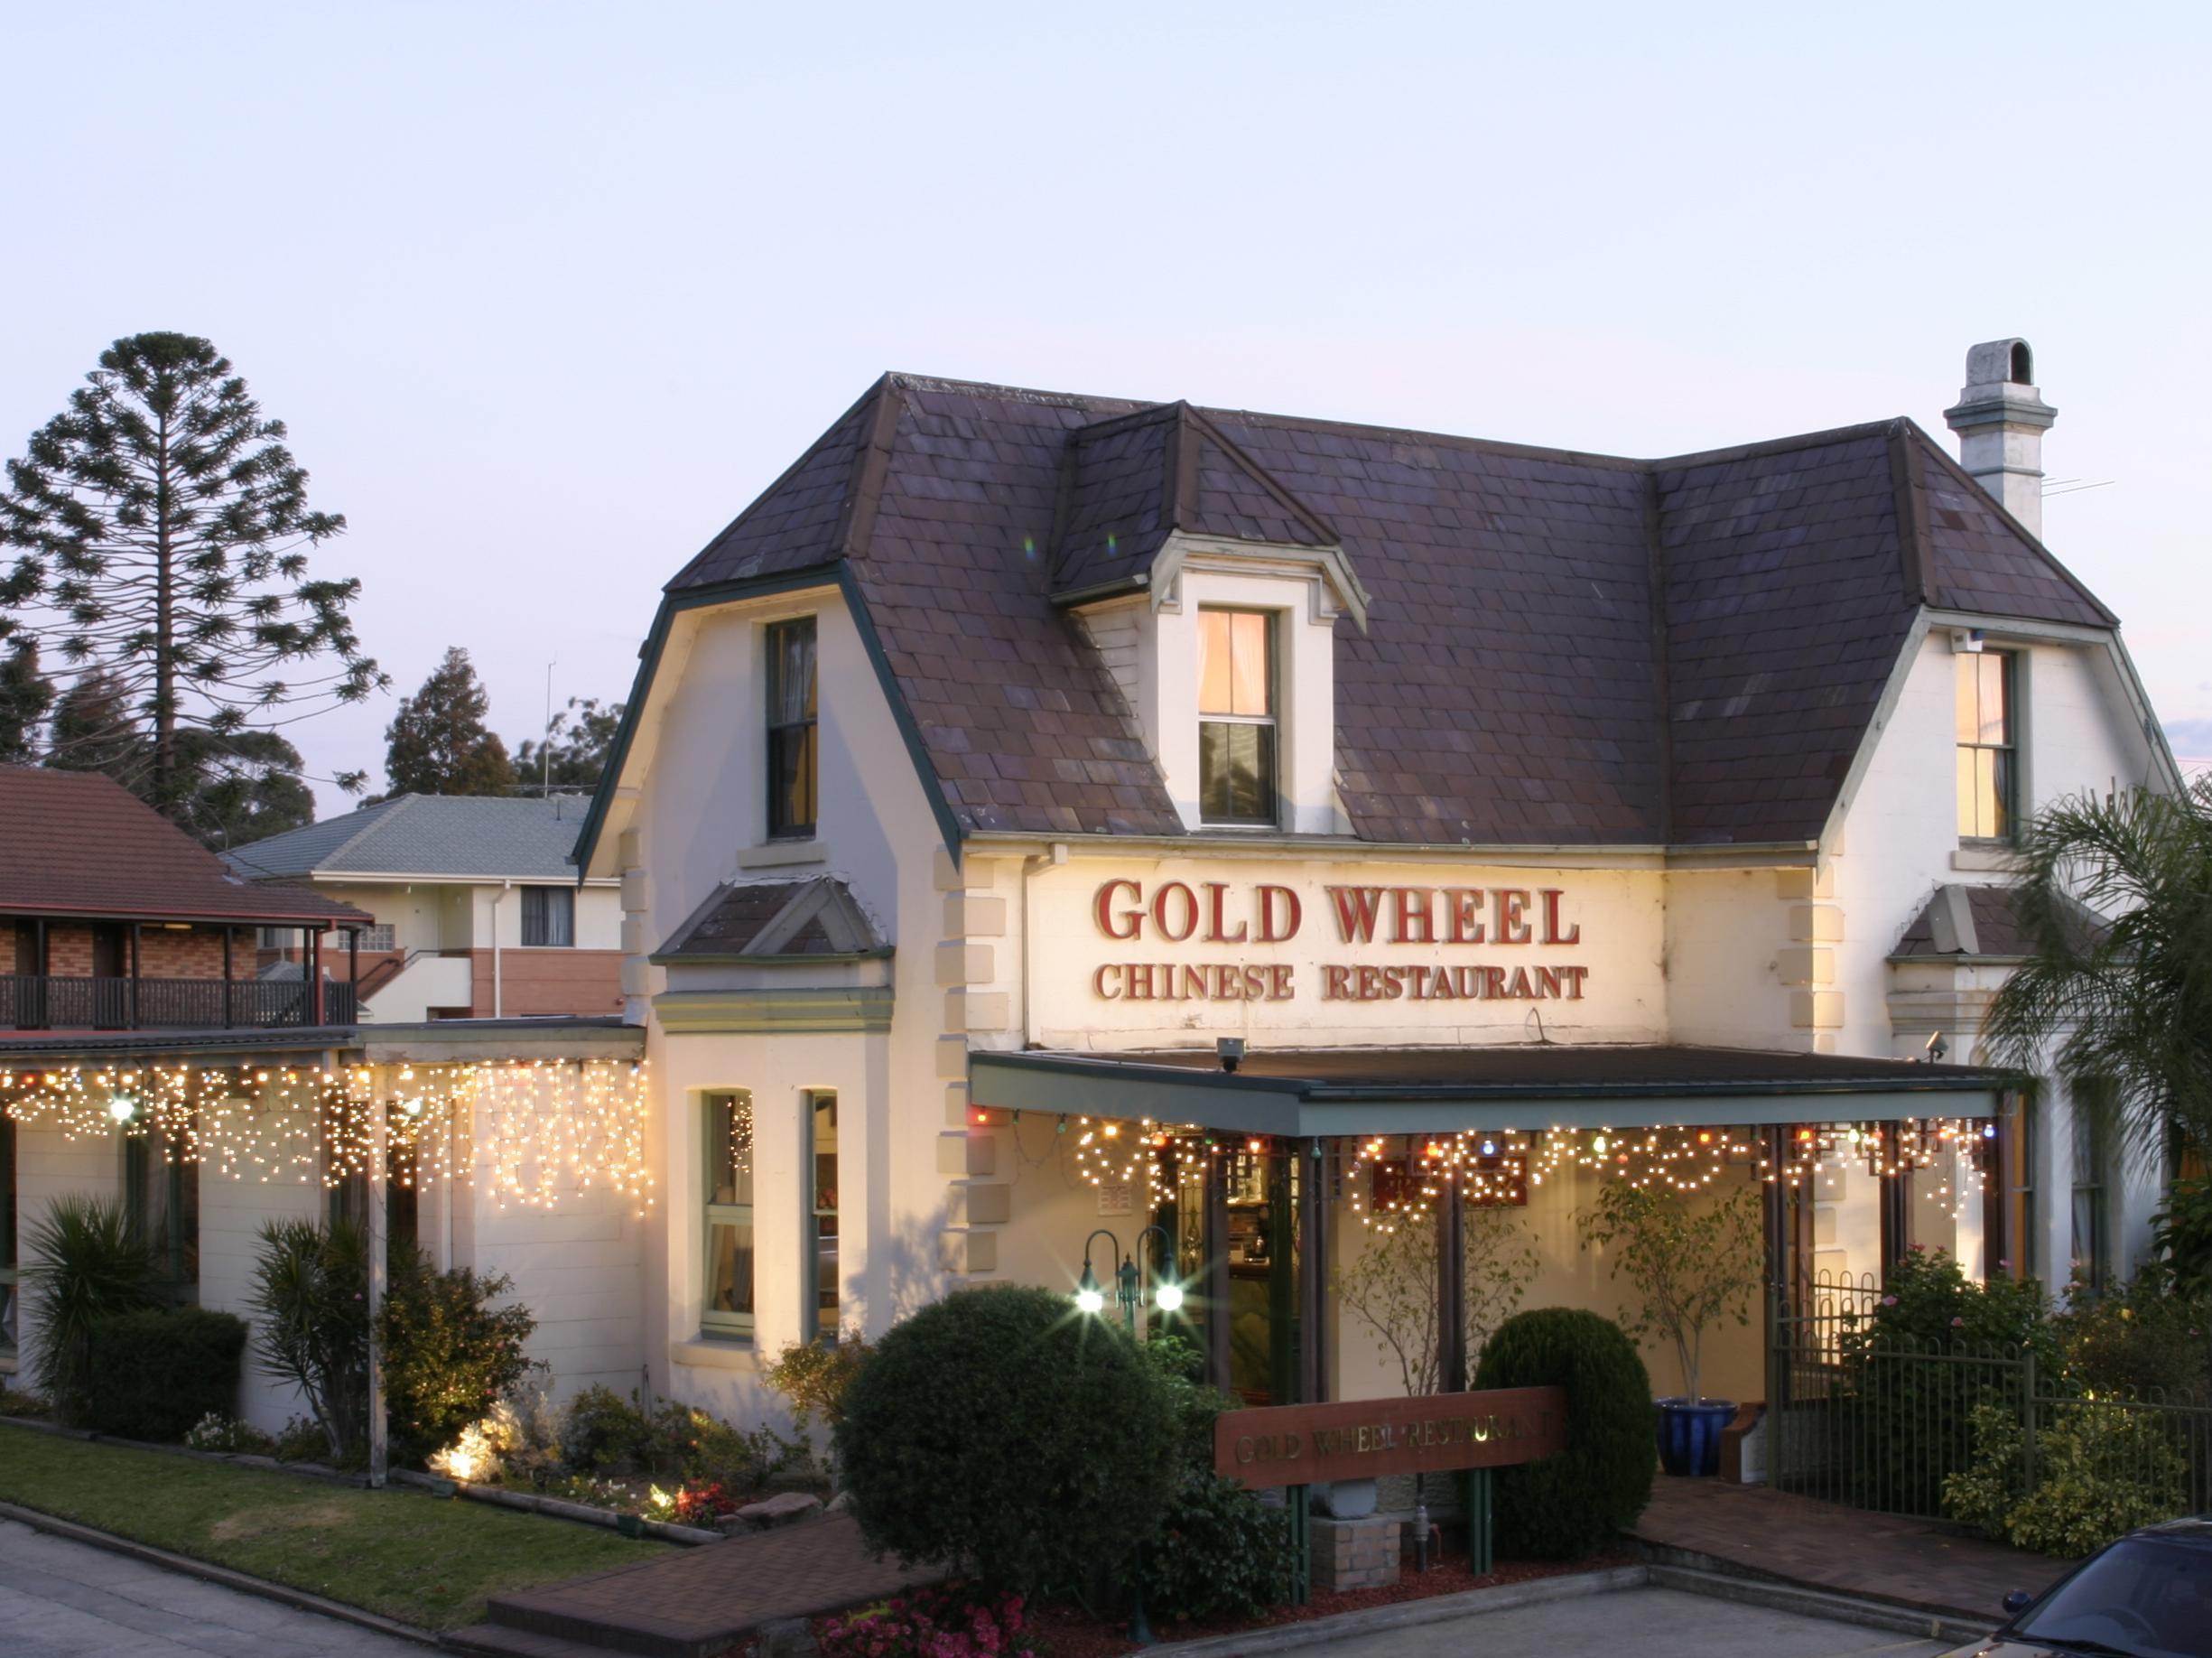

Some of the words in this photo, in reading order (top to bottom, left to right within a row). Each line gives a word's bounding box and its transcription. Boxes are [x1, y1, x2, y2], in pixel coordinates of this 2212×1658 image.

[1092, 879, 1302, 943] GOLD
[1324, 885, 1581, 945] WHEEL
[1092, 964, 1296, 1001] CHINESE
[1321, 964, 1589, 1001] RESTAURANT
[1235, 1430, 1301, 1465] GOLD
[1312, 1424, 1398, 1457] WHEEL
[1407, 1411, 1554, 1448] RESTAURANT
